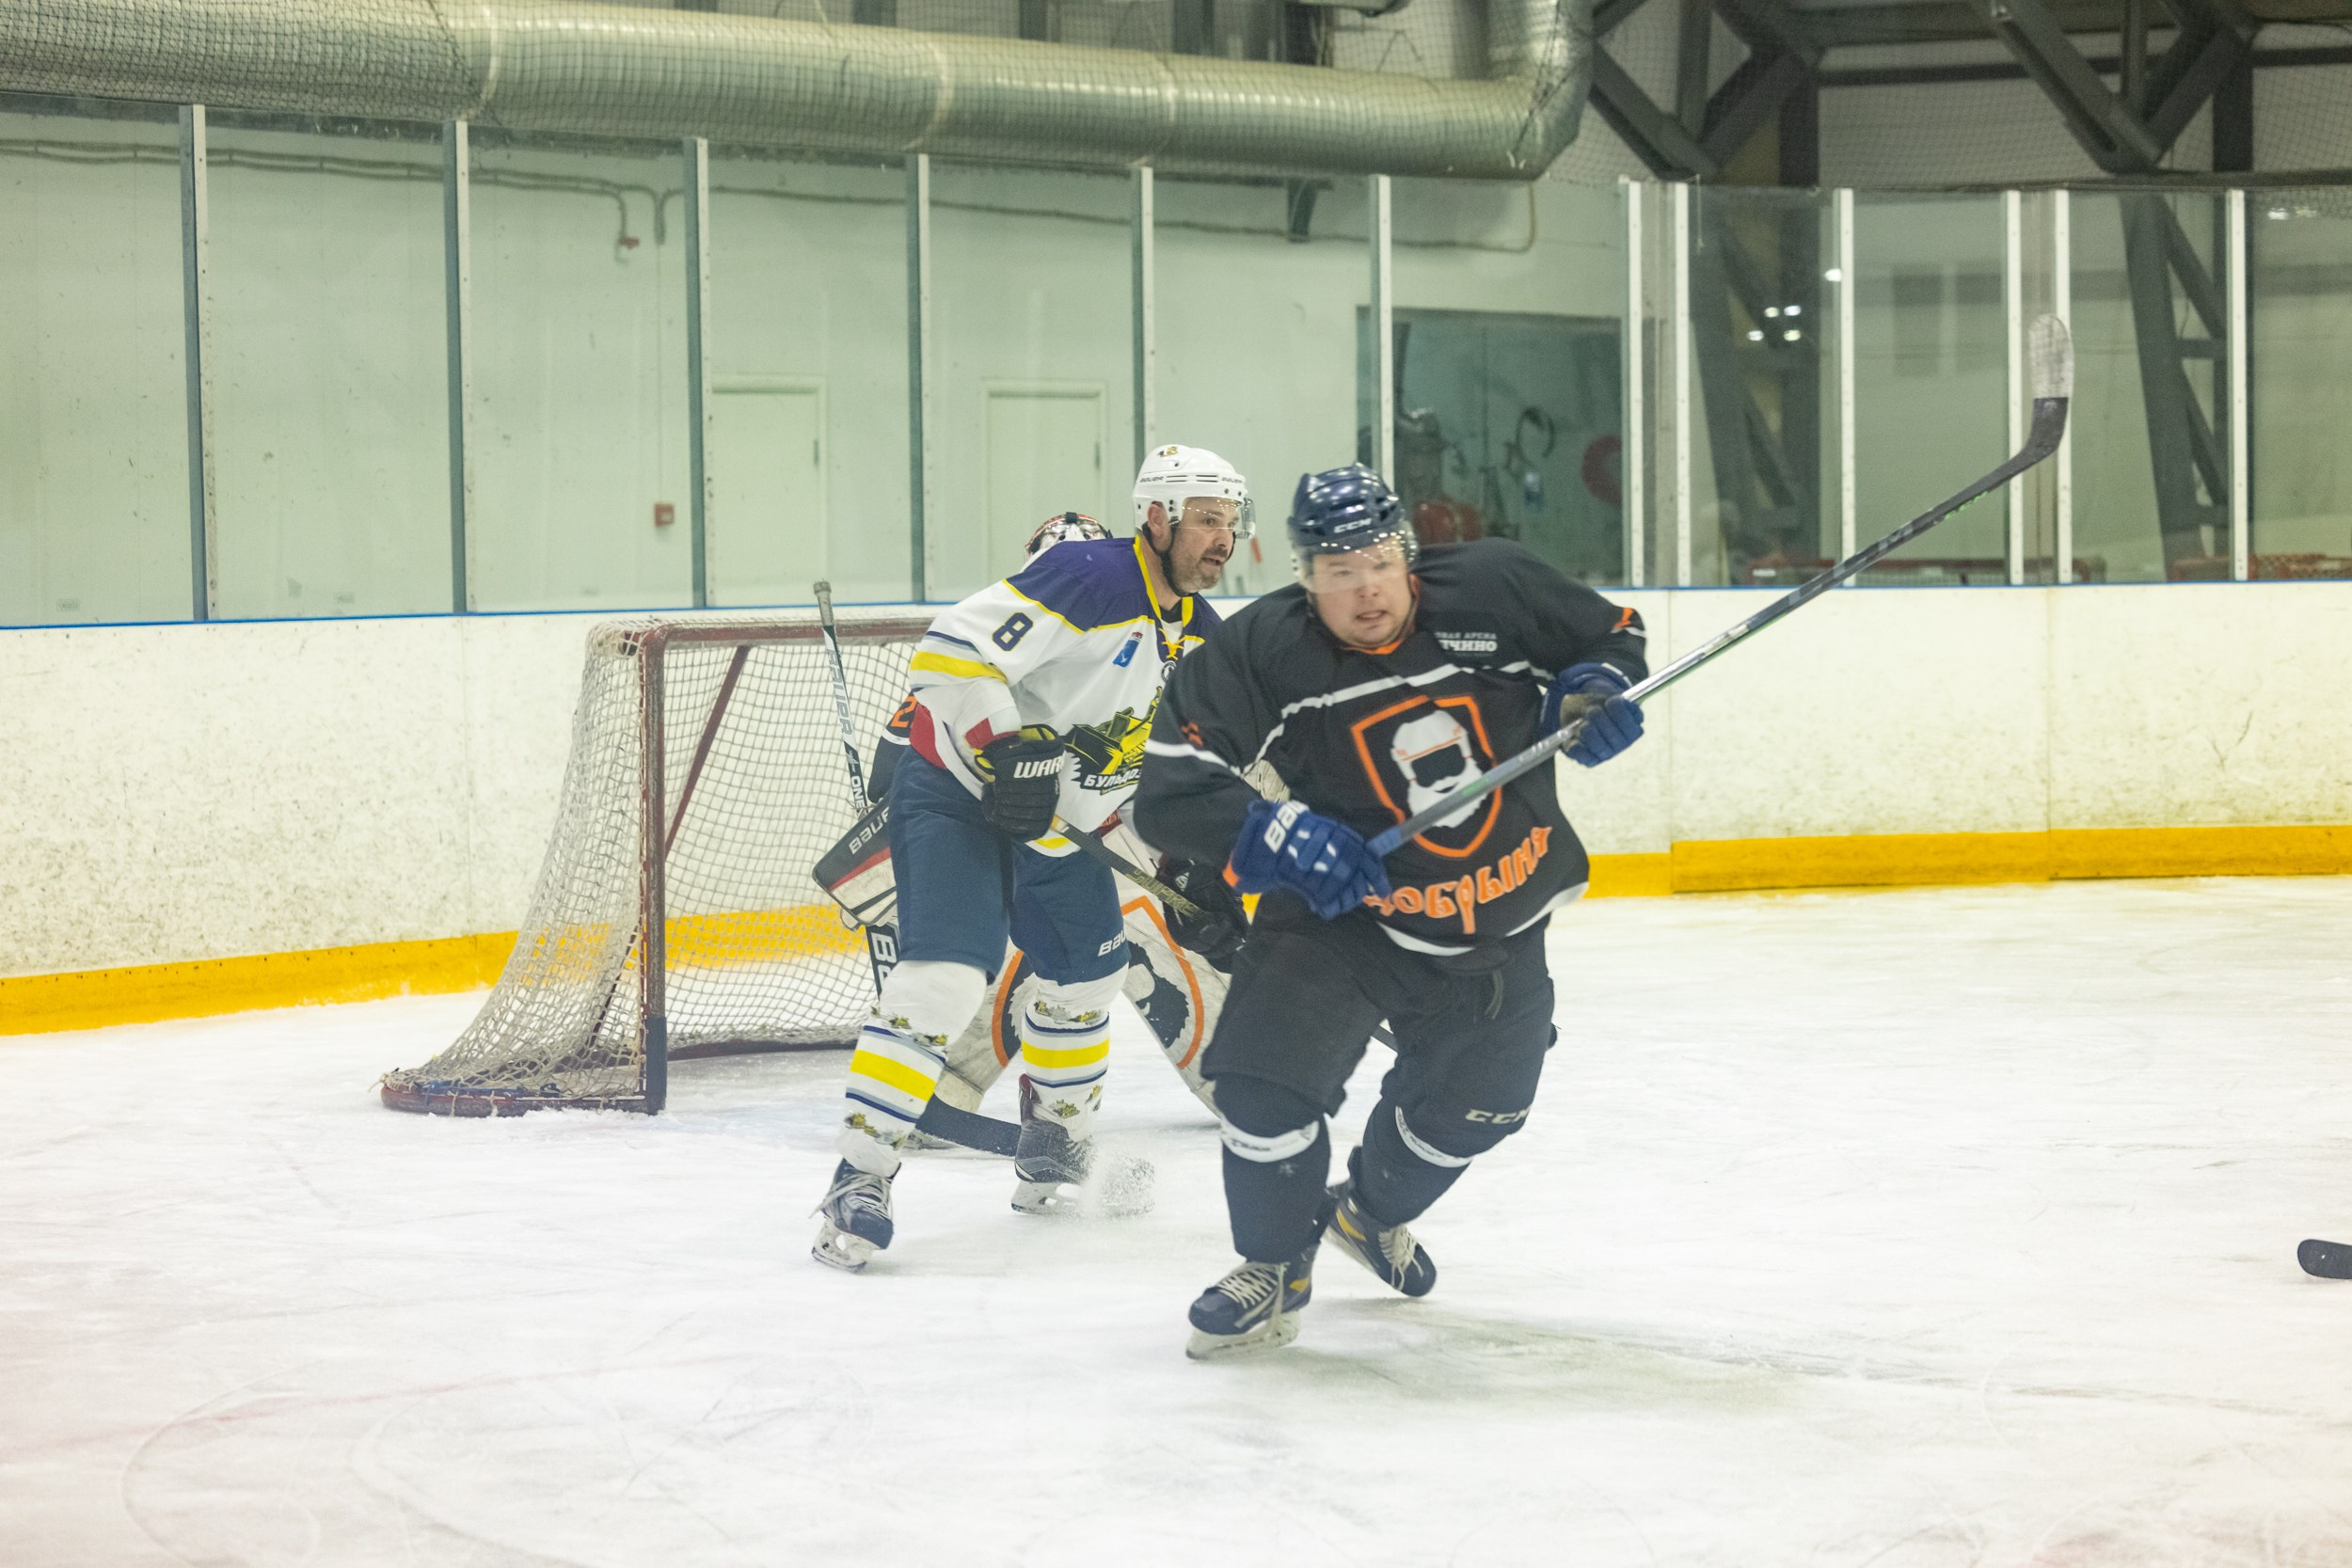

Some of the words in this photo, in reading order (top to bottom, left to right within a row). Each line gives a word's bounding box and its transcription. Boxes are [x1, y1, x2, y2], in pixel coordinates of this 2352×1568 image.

[1334, 517, 1372, 533] CCM
[992, 611, 1034, 652] 8
[850, 775, 866, 809] ONE
